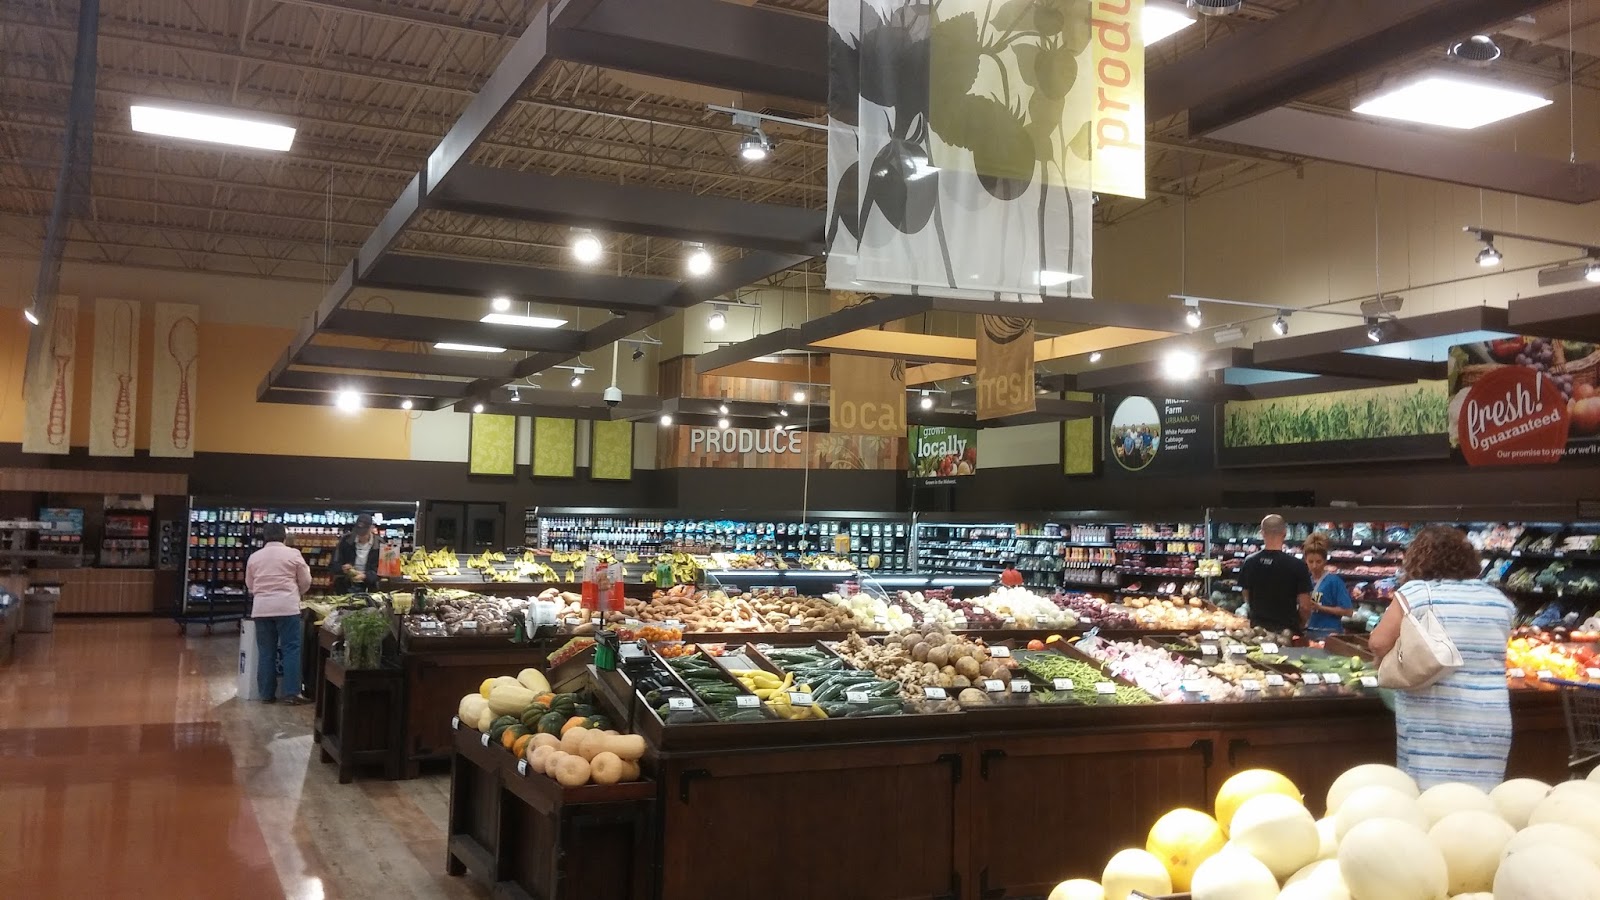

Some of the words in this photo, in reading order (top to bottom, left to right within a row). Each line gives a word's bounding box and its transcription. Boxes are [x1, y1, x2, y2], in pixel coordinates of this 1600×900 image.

[976, 358, 1034, 410] fresh
[830, 389, 905, 431] local
[1165, 406, 1182, 414] Farm
[1467, 371, 1544, 450] fresh!
[690, 428, 802, 454] PRODUCE
[923, 426, 946, 439] grown
[1480, 408, 1561, 451] guaranteed
[917, 434, 968, 460] locally
[1496, 449, 1510, 459] Our
[1511, 448, 1541, 459] promise
[1542, 447, 1550, 456] to
[1550, 447, 1567, 457] you,
[1568, 447, 1577, 455] or
[1578, 444, 1596, 455] we'll
